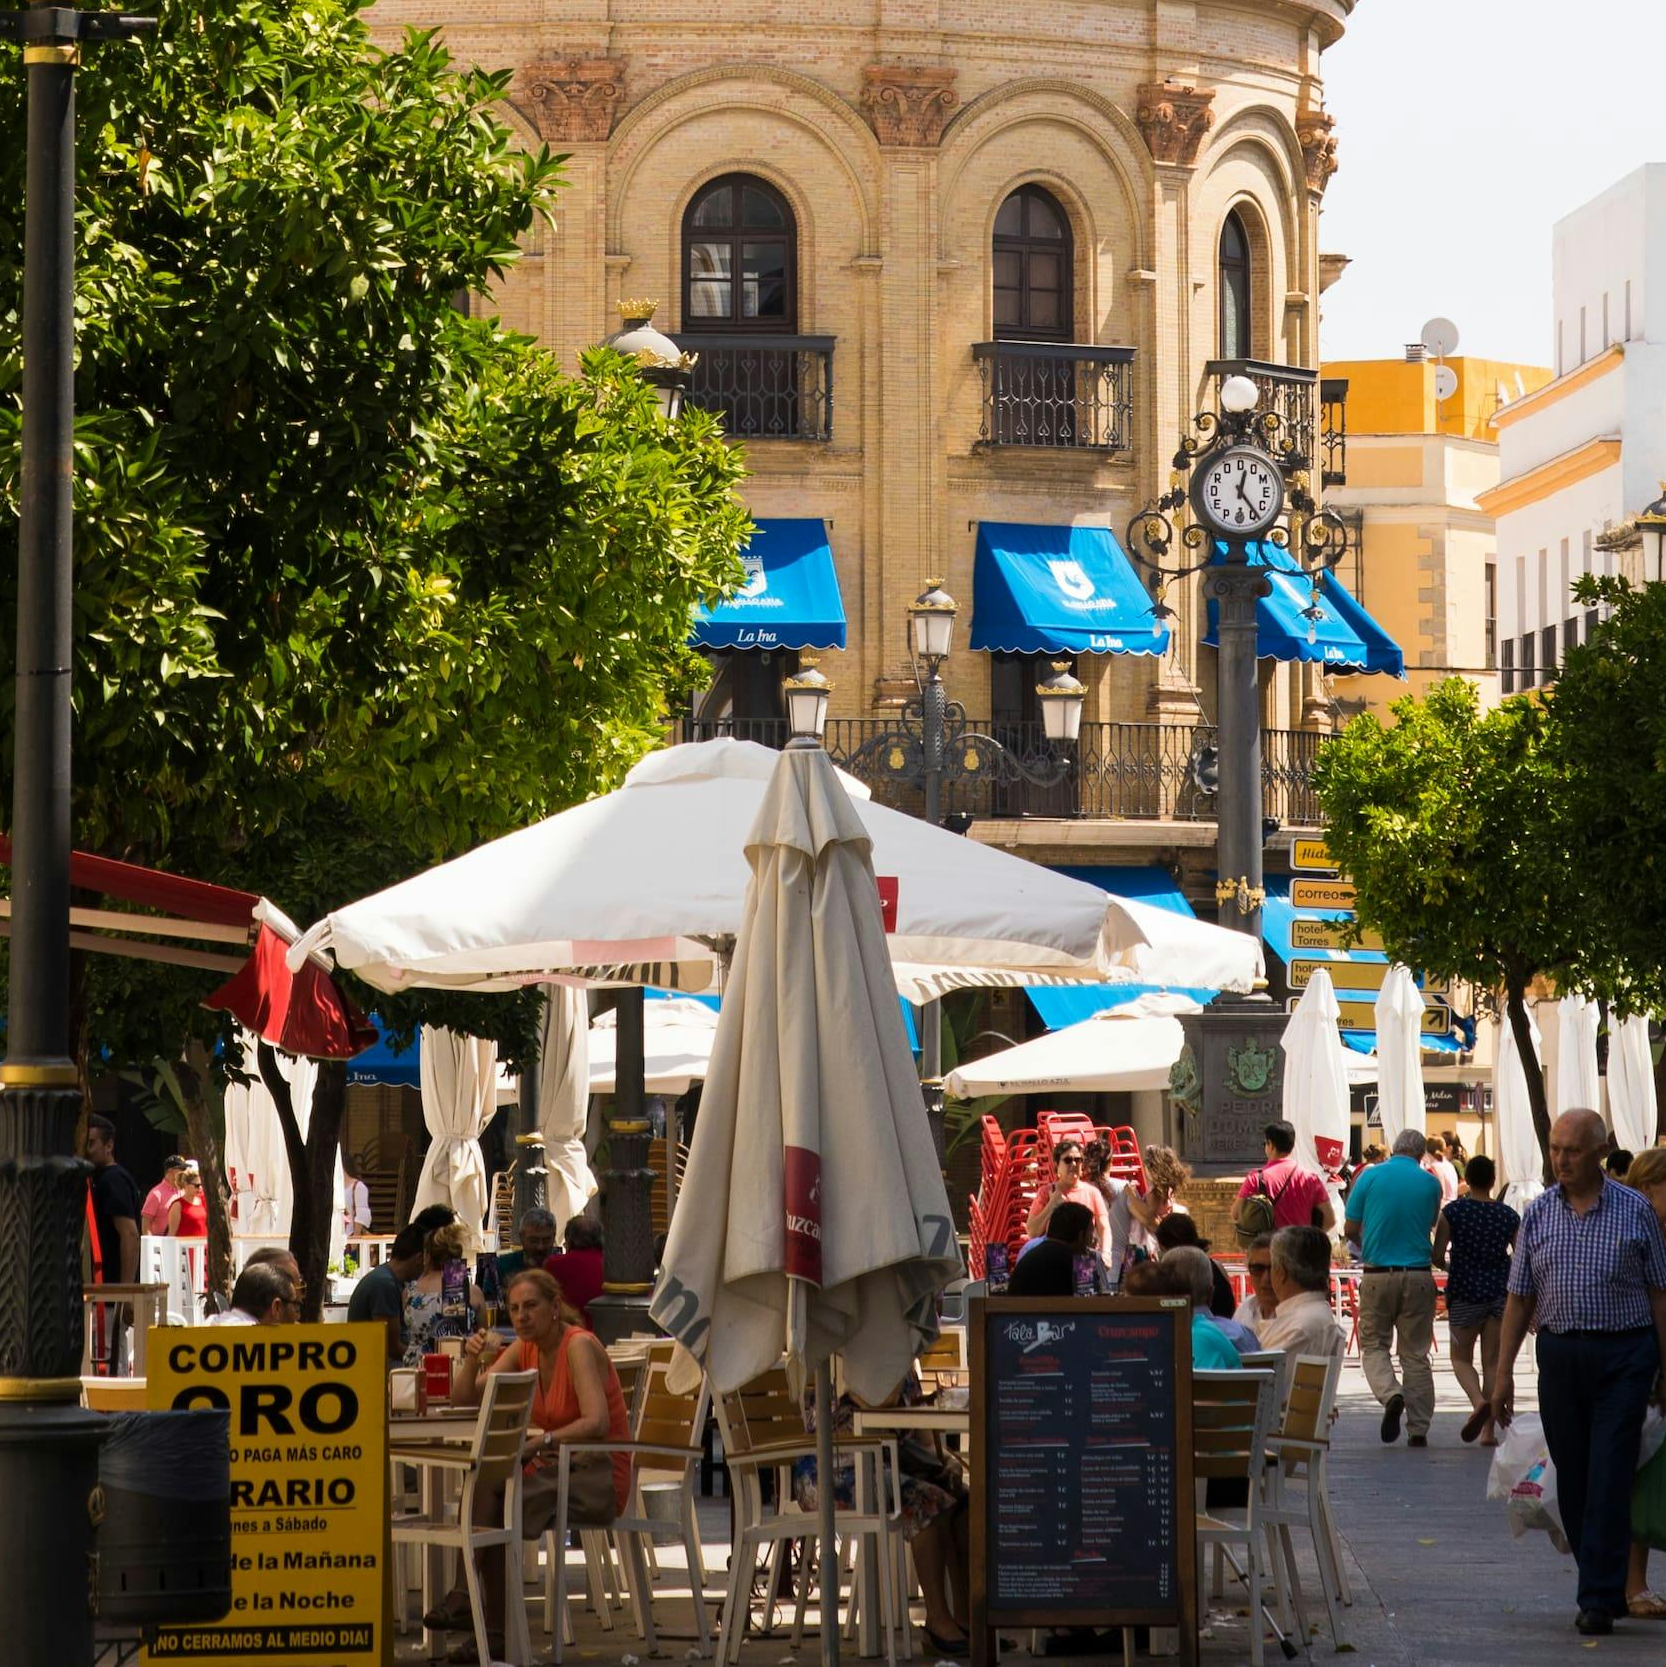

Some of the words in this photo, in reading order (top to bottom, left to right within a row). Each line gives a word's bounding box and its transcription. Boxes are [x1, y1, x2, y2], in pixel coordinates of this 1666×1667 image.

[737, 629, 755, 643] La
[756, 629, 777, 643] Ina
[1297, 924, 1324, 935] hotel
[1297, 936, 1329, 946] Torres
[168, 1340, 357, 1374] COMPRO
[244, 1447, 282, 1463] PAGA
[286, 1443, 318, 1462] MÁS
[322, 1445, 363, 1461] CARO
[230, 1477, 356, 1508] RARIO
[262, 1521, 271, 1532] a
[275, 1516, 328, 1532] Sábado
[258, 1552, 279, 1570] la
[283, 1550, 377, 1570] Mañana
[253, 1592, 274, 1610] la
[279, 1591, 355, 1609] Noche
[182, 1632, 263, 1650] CERRAMOS
[266, 1632, 285, 1648] AL
[289, 1630, 336, 1647] MEDIO
[339, 1629, 369, 1646] DIA!
